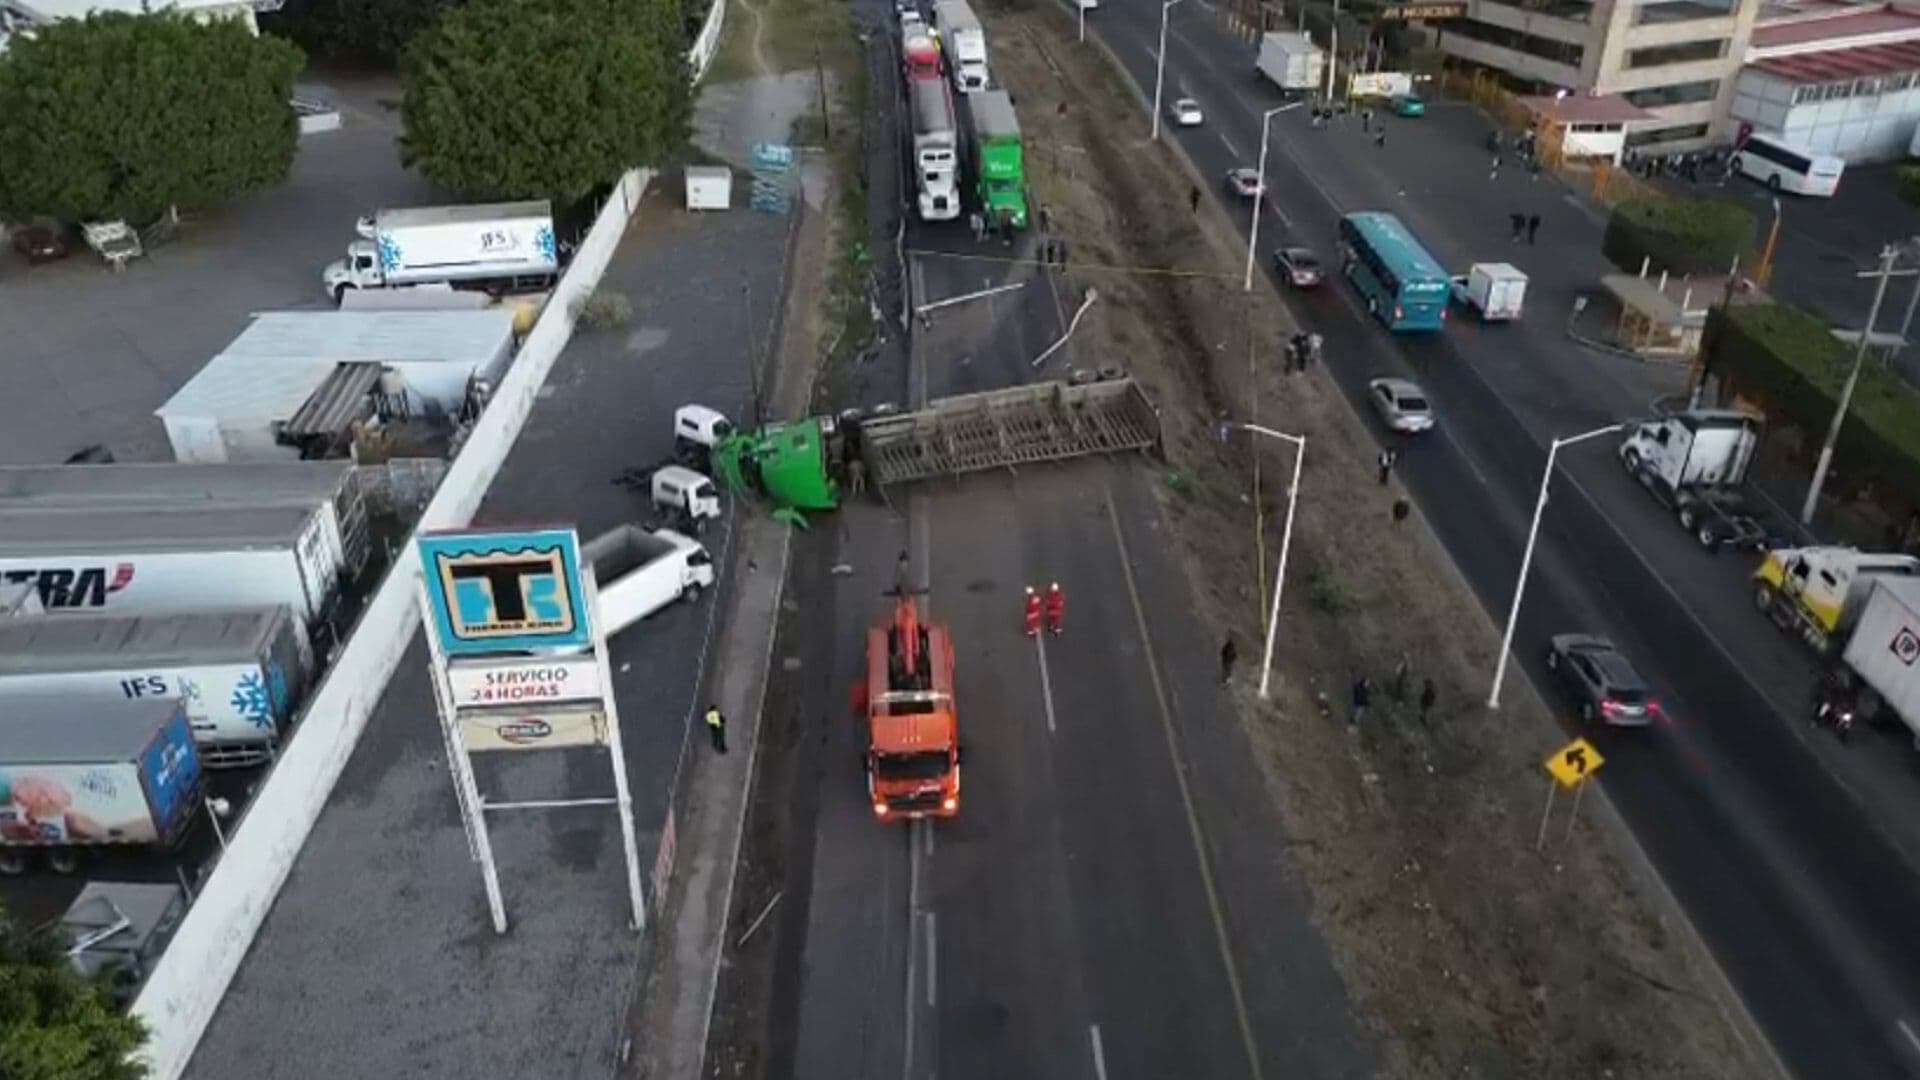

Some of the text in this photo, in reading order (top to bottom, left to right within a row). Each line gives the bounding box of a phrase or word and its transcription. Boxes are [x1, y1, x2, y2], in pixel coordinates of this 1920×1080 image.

[485, 667, 568, 684] SERVICIO
[121, 675, 167, 699] IFS
[471, 684, 559, 701] 24 HORAS
